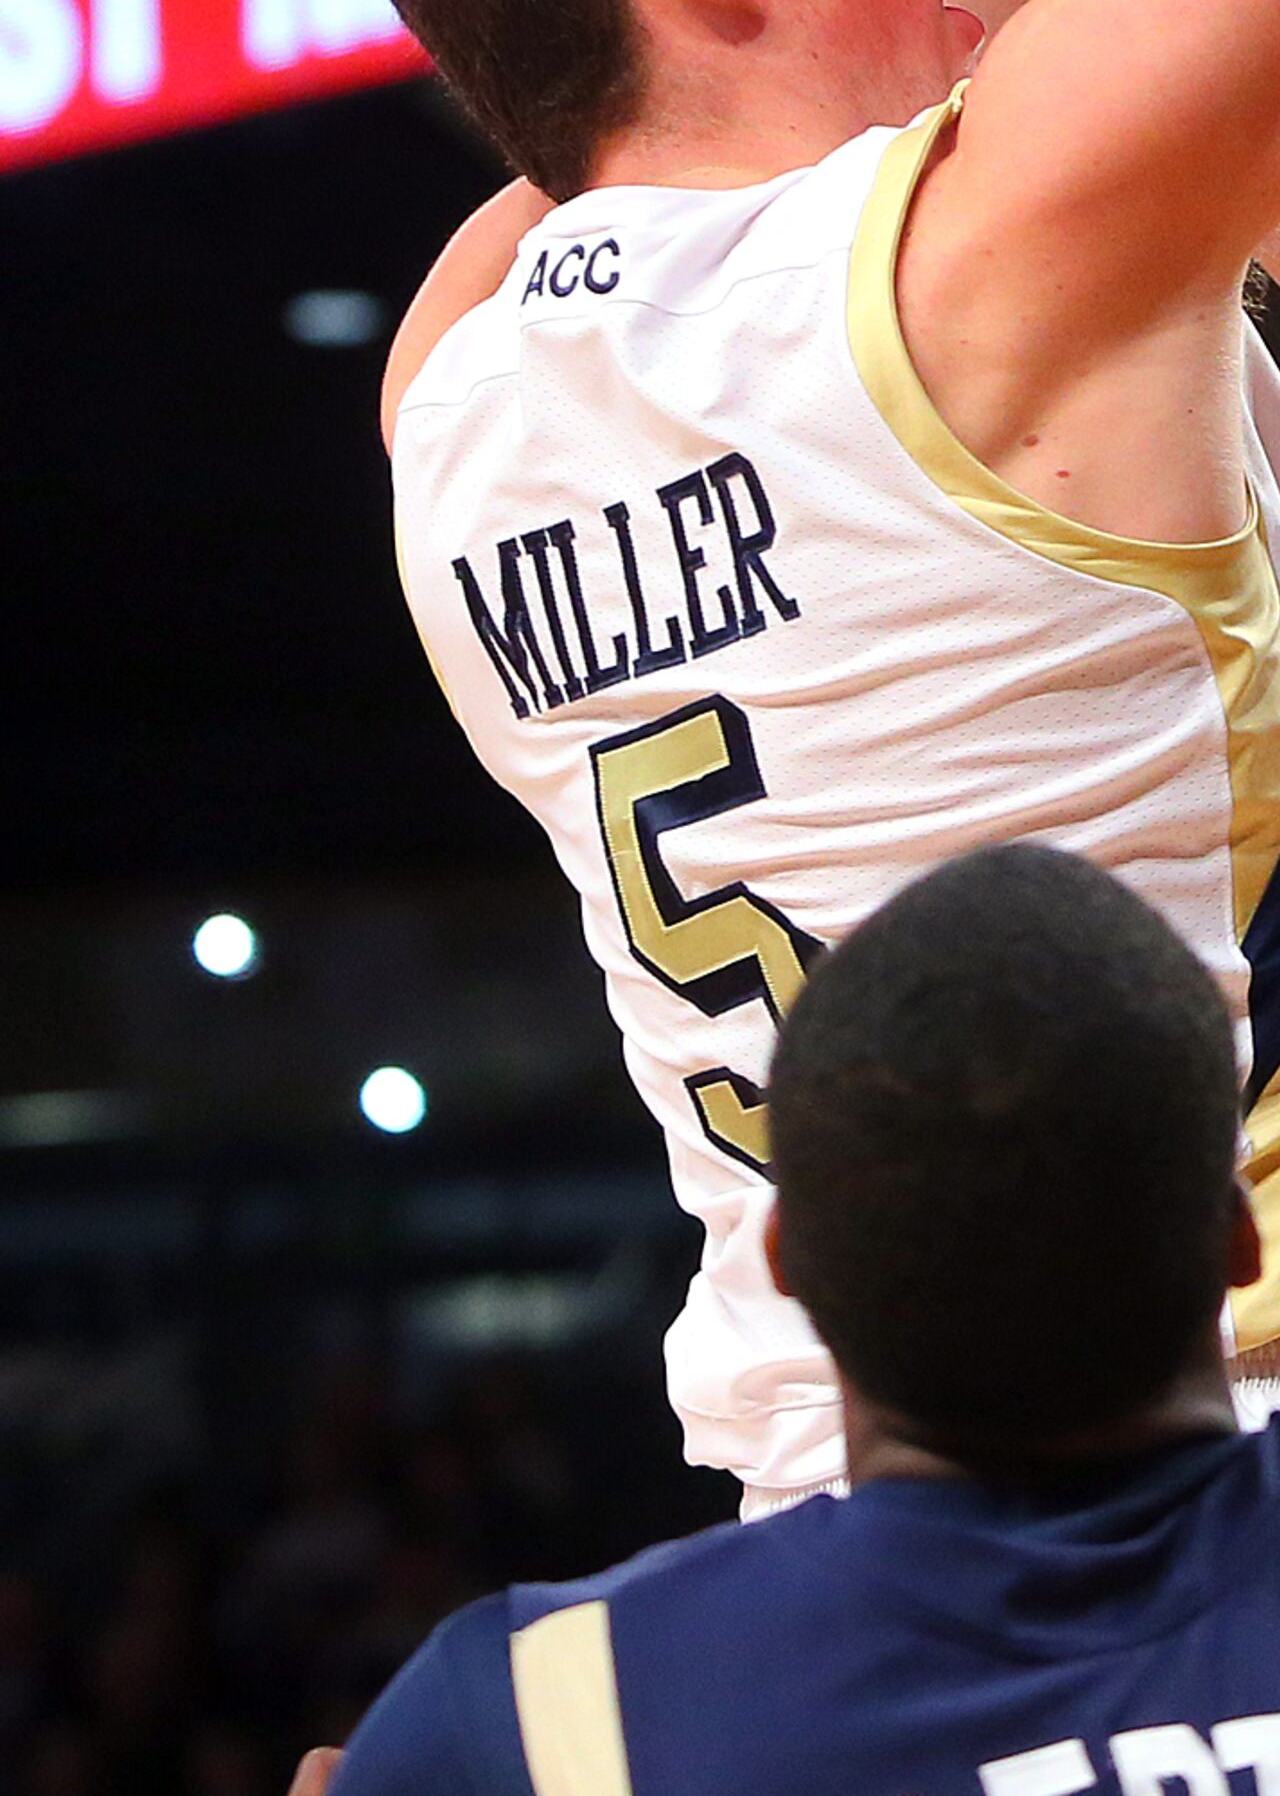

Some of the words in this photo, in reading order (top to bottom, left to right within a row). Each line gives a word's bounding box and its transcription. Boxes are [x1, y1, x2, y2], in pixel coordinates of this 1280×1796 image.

[521, 238, 620, 305] ACC
[451, 452, 801, 720] MILLER
[588, 694, 826, 1181] 5
